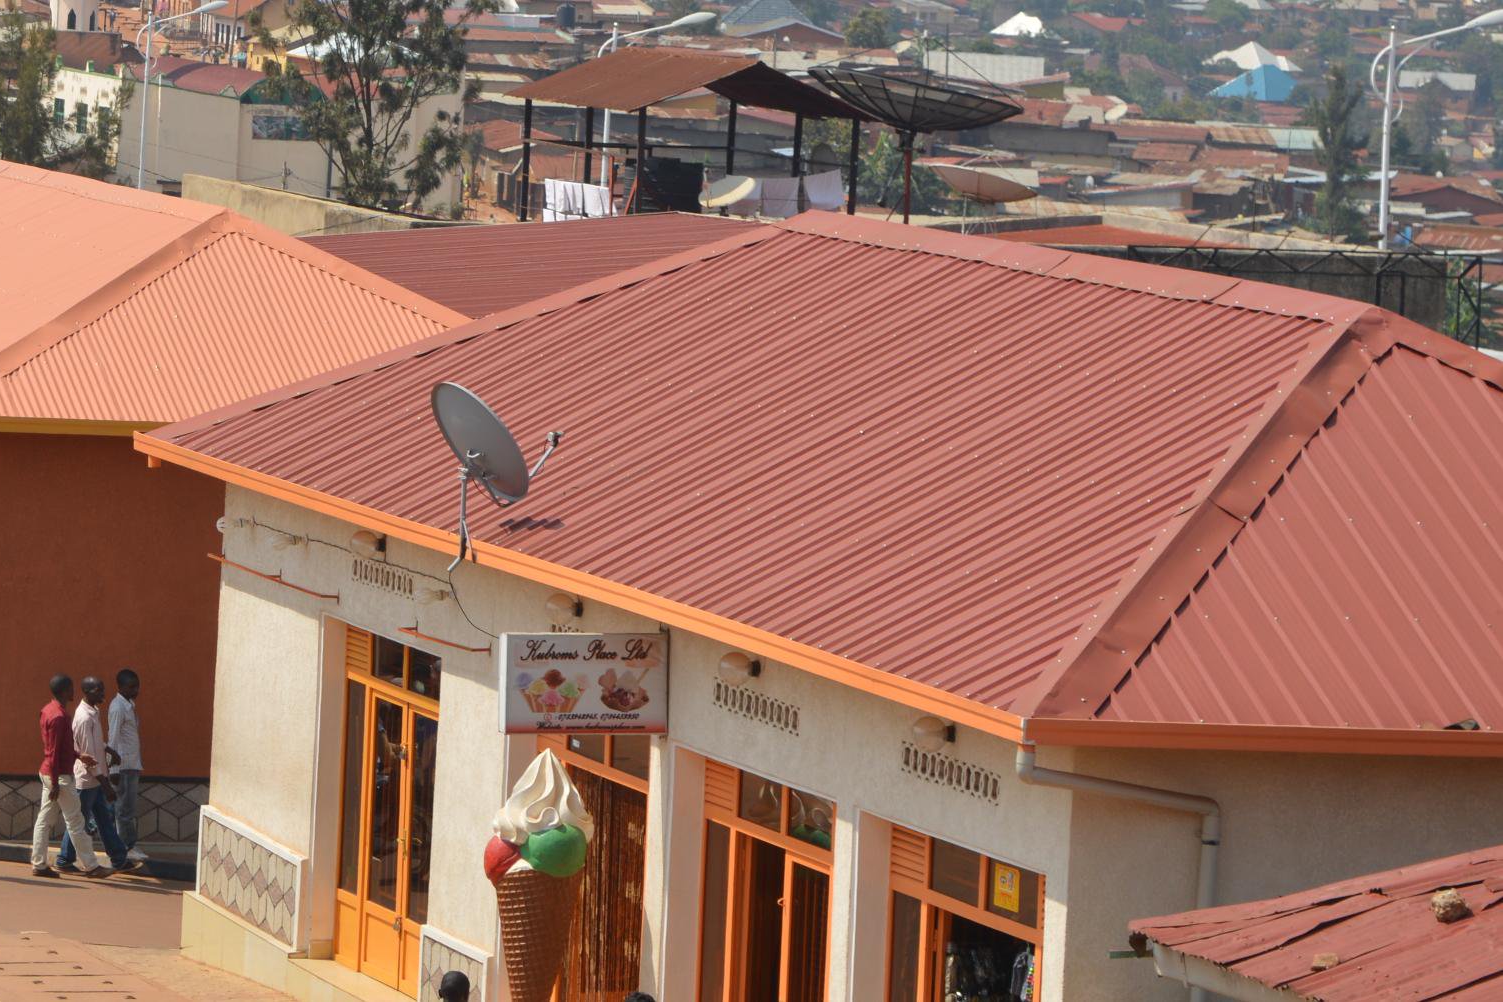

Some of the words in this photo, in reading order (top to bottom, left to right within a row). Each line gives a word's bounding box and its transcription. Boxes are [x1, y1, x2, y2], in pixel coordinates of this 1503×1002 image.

[520, 640, 579, 661] Kubroms
[583, 639, 618, 660] Place
[621, 639, 653, 660] Ltd
